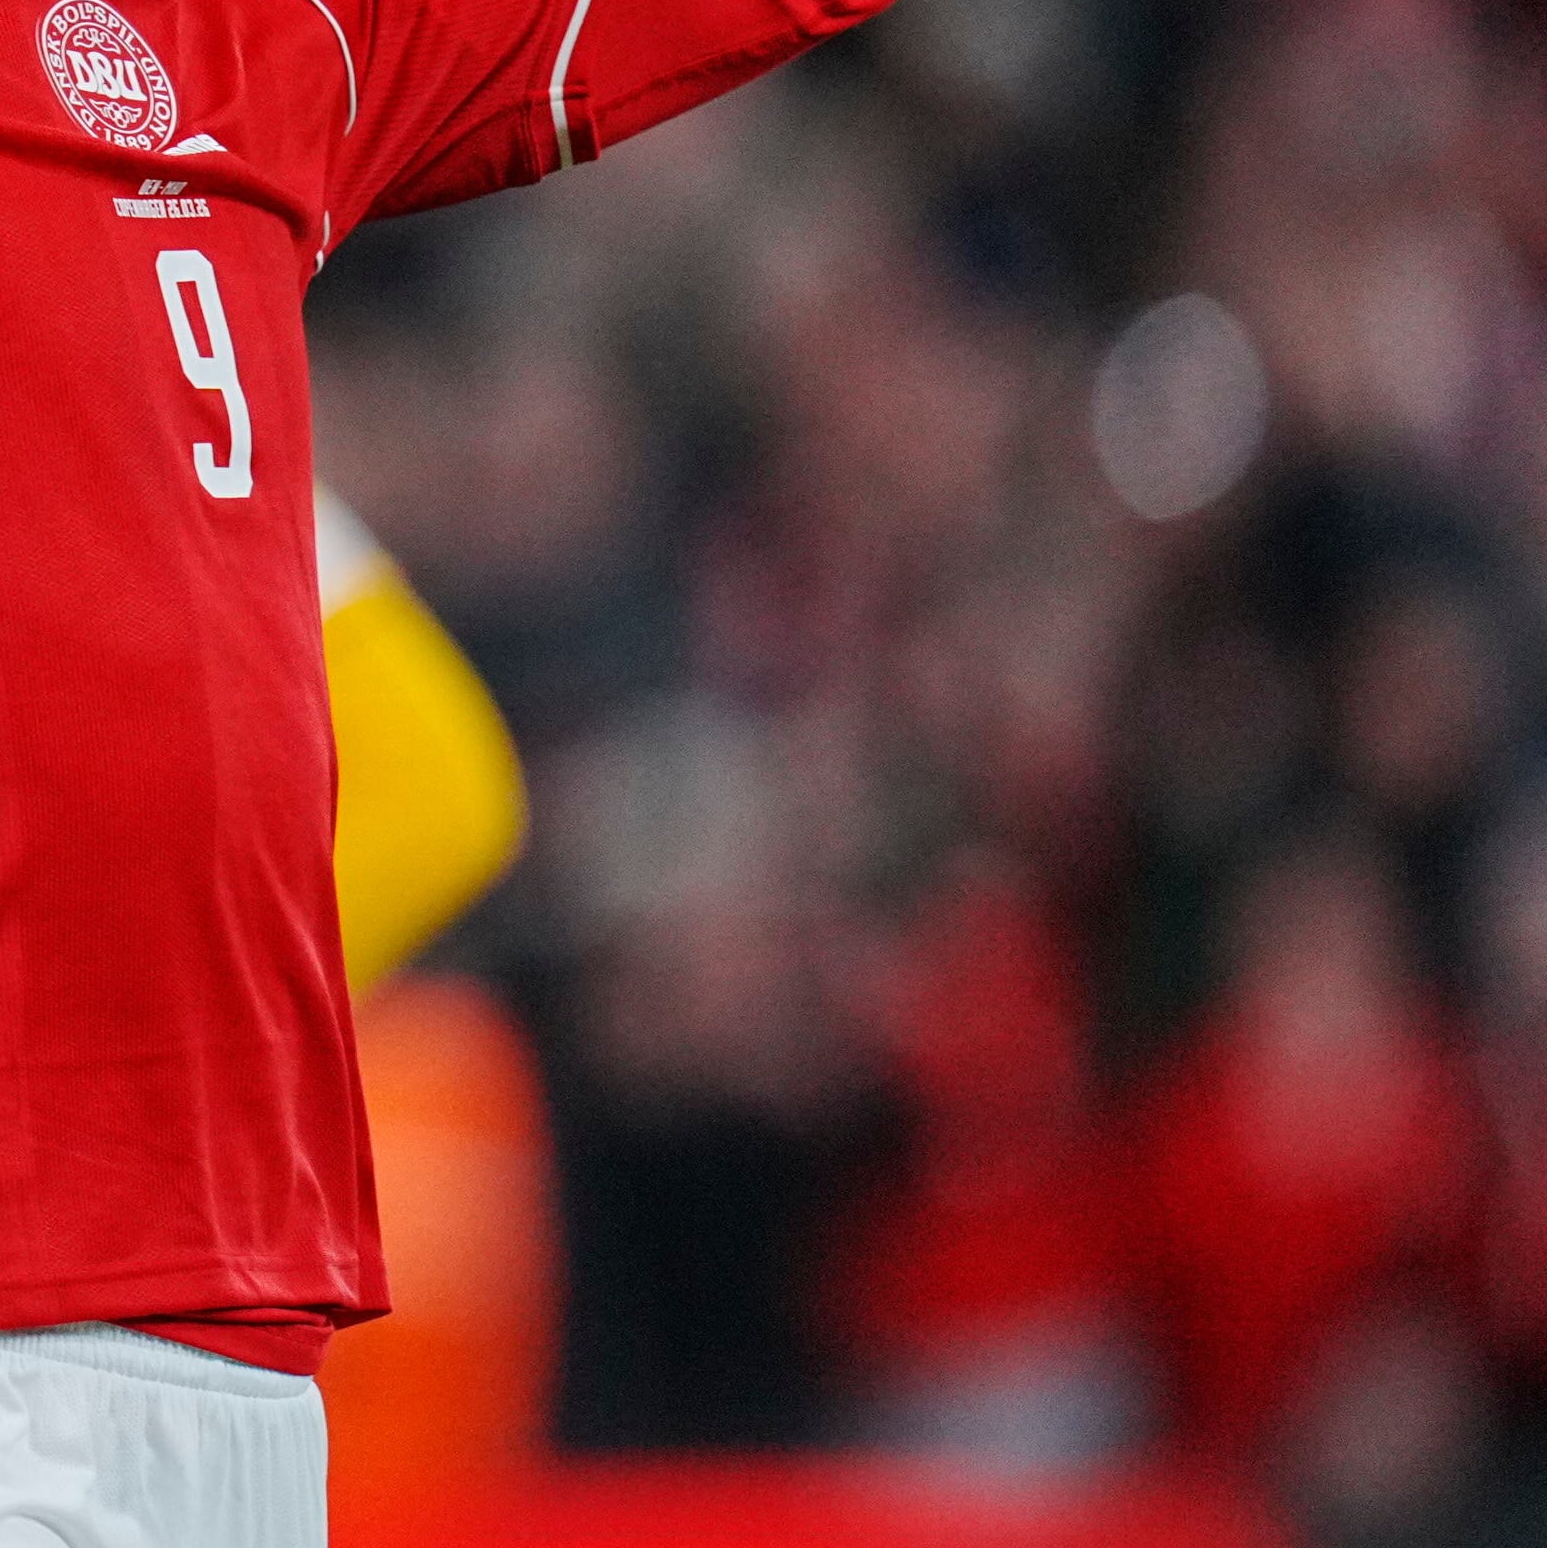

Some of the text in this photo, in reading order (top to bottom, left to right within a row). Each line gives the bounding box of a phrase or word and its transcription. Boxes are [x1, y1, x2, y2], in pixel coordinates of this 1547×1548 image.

[51, 2, 137, 51] BOLDSPIL
[140, 56, 171, 138] UNION
[66, 49, 148, 102] DBU
[155, 249, 254, 498] 9
